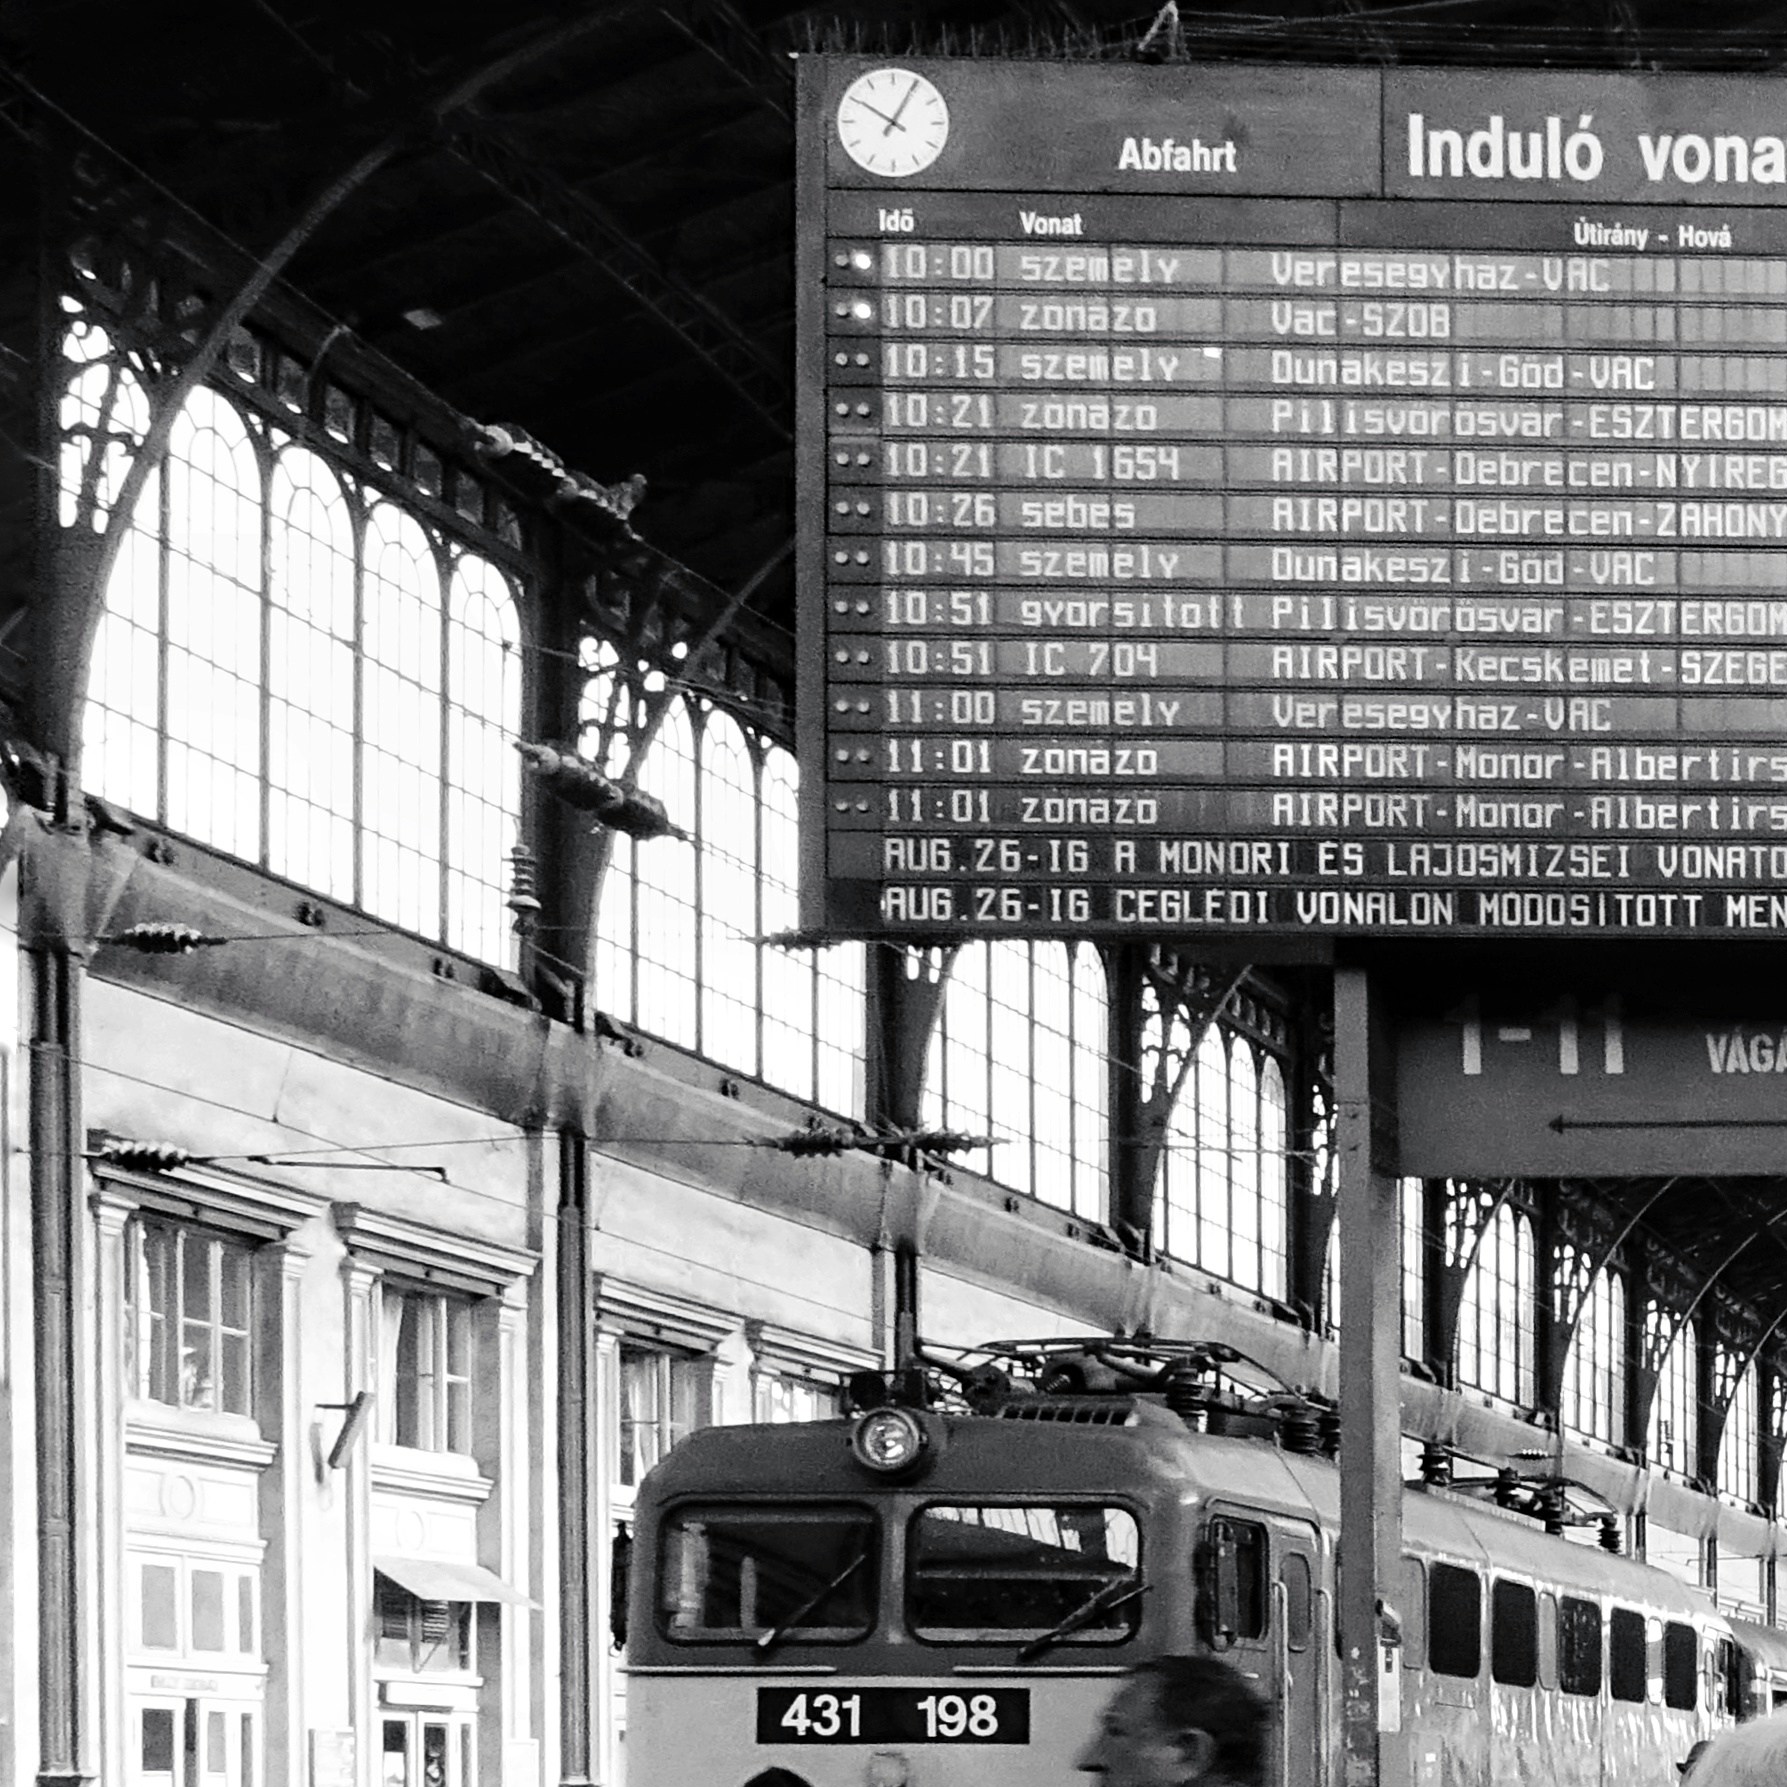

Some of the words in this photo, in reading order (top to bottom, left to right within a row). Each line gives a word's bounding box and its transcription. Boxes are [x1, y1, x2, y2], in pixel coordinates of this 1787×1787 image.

[1119, 138, 1236, 172] Abfahrt
[1409, 114, 1603, 181] Induló
[879, 209, 914, 231] Idő
[1020, 212, 1083, 235] Vonat
[1575, 217, 1648, 250] Útirány
[1679, 224, 1731, 247] Hová
[889, 247, 996, 282] 10:00
[889, 296, 996, 331] 10:07
[889, 345, 996, 380] 10:15
[889, 394, 996, 429] 10:21
[889, 444, 996, 478] 10:21
[1024, 445, 1064, 479] IC
[1092, 446, 1178, 481] 1654
[889, 493, 996, 527] 10:26
[889, 542, 996, 577] 10:45
[888, 592, 996, 626] 10:51
[888, 641, 996, 675] 10:51
[1024, 643, 1064, 676] IC
[1089, 643, 1155, 677] 704
[888, 691, 996, 725] 11:00
[888, 740, 996, 774] 11:01
[888, 790, 996, 824] 11:01
[1111, 842, 1132, 875] A
[1157, 842, 1293, 877] MONORI
[1295, 891, 1452, 925] VONALON
[781, 1694, 860, 1736] 431
[918, 1695, 998, 1737] 198
